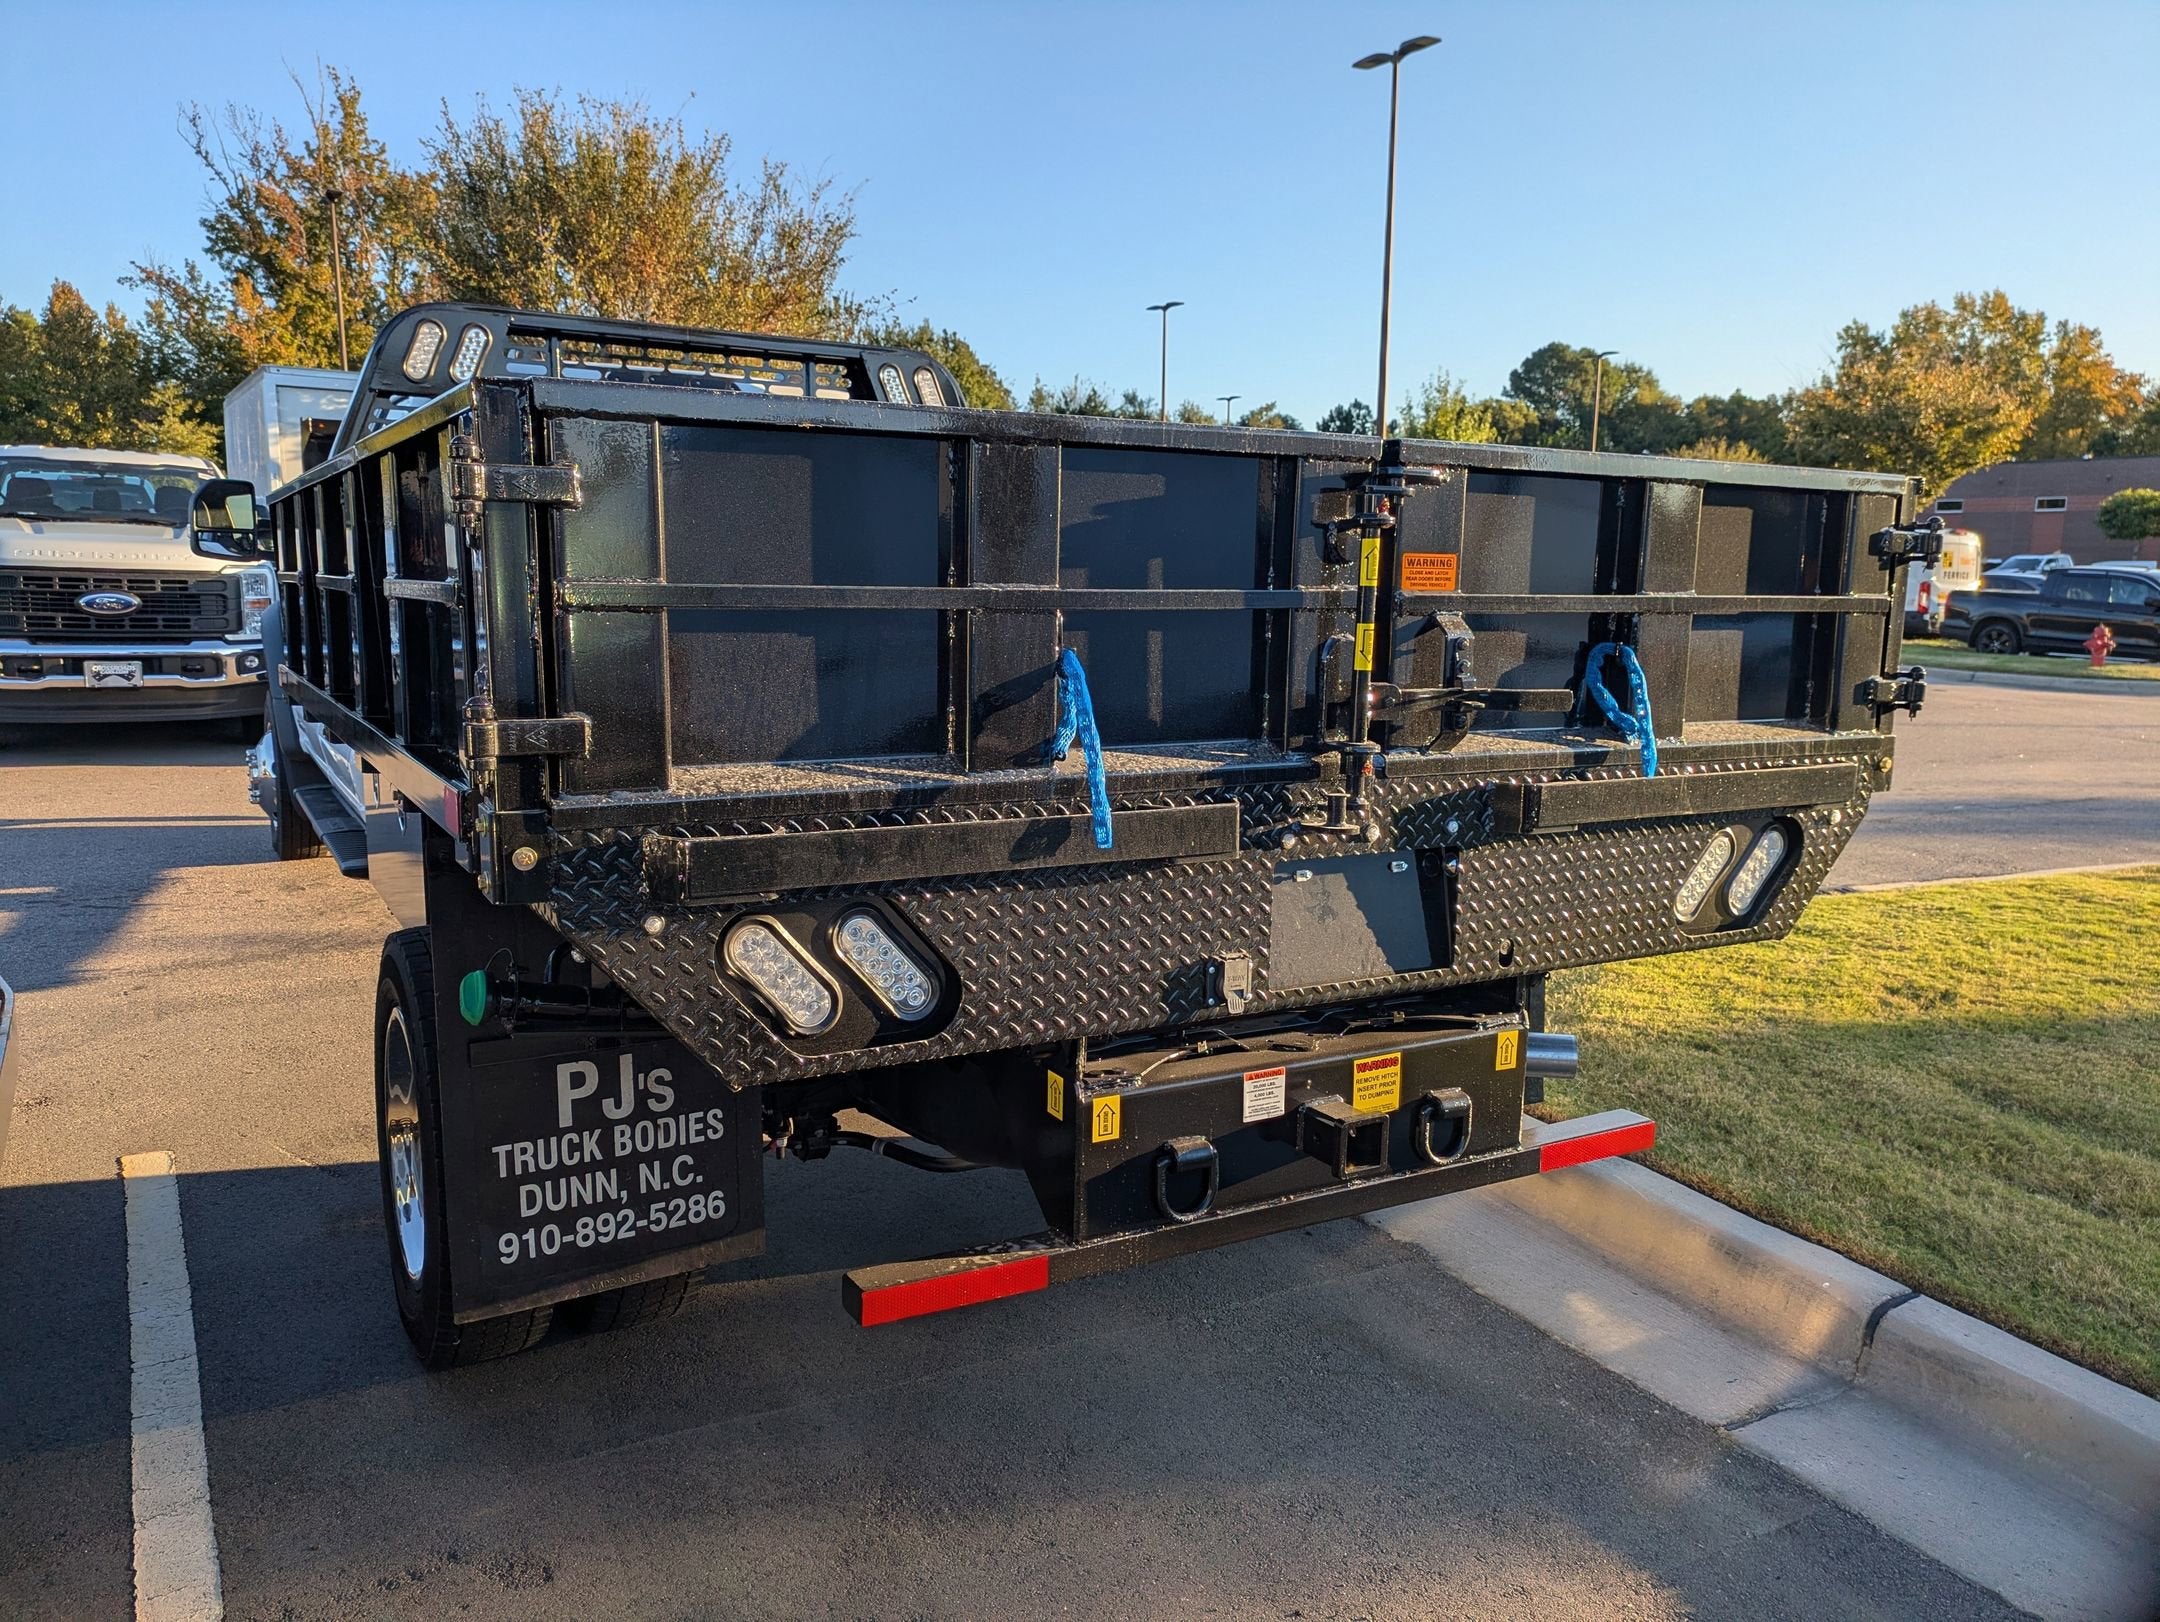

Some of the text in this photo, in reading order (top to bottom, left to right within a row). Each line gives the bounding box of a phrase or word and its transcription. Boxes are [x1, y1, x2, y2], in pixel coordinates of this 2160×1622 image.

[1406, 558, 1452, 568] WARNING
[1355, 1056, 1399, 1073] WARNING
[1254, 1069, 1282, 1079] WARNING
[1355, 1071, 1399, 1085] REMOVE HITCH
[1356, 1079, 1397, 1093] INSERT PRIOR
[1368, 1088, 1394, 1099] DUMPING
[491, 1108, 724, 1178] TRUCK BODIES
[518, 1153, 704, 1218] DUNN, N.C.
[498, 1189, 726, 1265] 910-892-5286
[628, 1271, 647, 1282] USA
